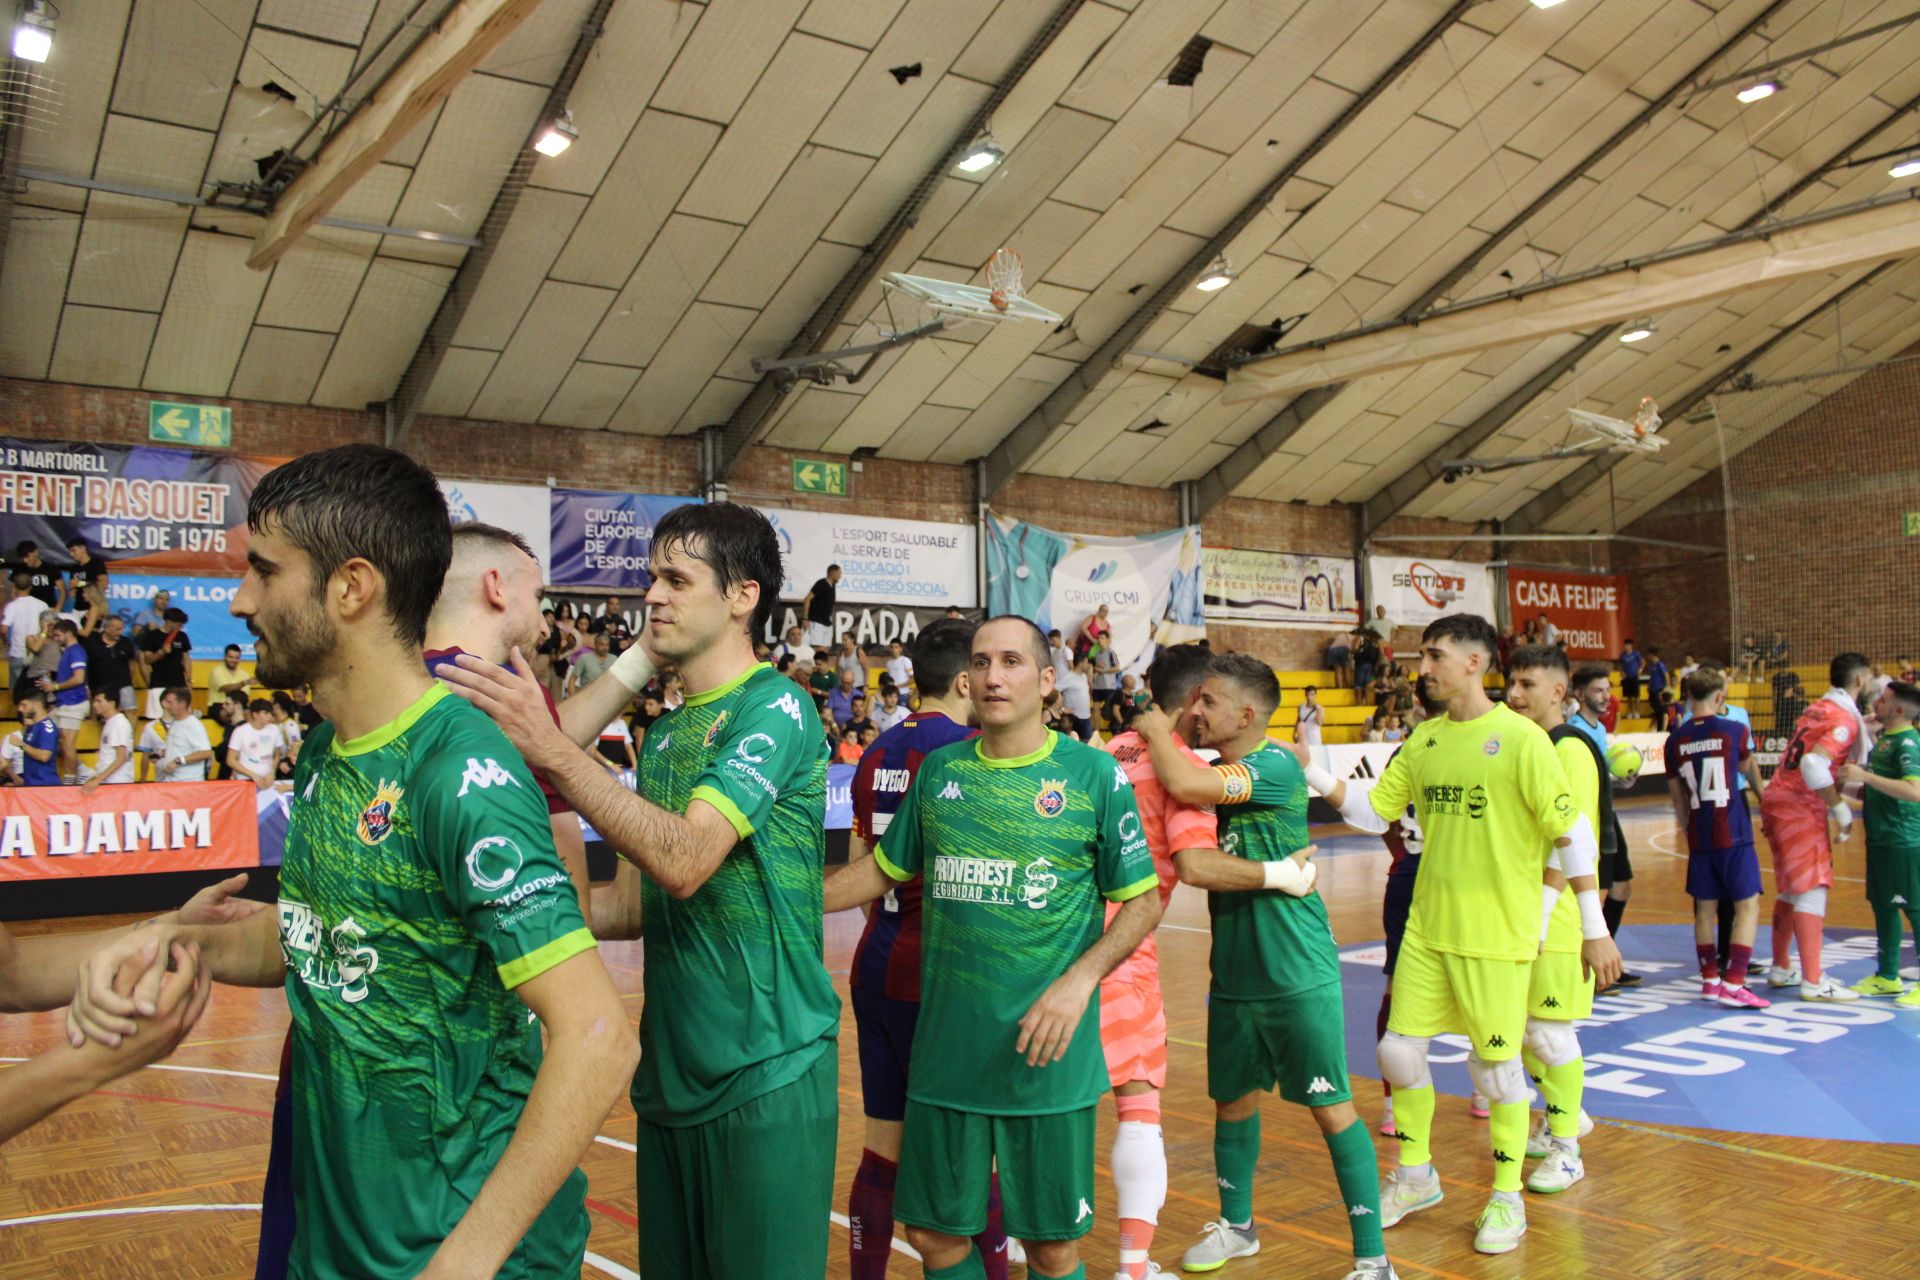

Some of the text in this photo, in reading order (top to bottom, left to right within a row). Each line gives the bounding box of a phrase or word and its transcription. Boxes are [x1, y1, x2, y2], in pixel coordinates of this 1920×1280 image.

[7, 448, 18, 466] B
[21, 450, 108, 472] MARTORELL
[84, 476, 230, 525] BASQUET
[585, 508, 636, 523] CIUTAT
[101, 524, 227, 553] DES DE 1975
[585, 524, 653, 540] EUROPEA
[832, 527, 959, 549] L'ESPORT SALUDABLE
[585, 540, 606, 554] DE
[833, 543, 911, 560] AL SERVEI DE
[851, 578, 904, 592] COHESIÓ
[907, 581, 949, 595] SOCIAL
[1064, 588, 1139, 605] GRUPO CMI
[1516, 580, 1618, 611] CASA FELIPE
[1679, 738, 1723, 756] PUIGVERT
[872, 768, 911, 793] DYEGO
[1678, 756, 1730, 810] 14
[47, 807, 213, 856] DAMM
[935, 858, 1017, 887] PROVEREST
